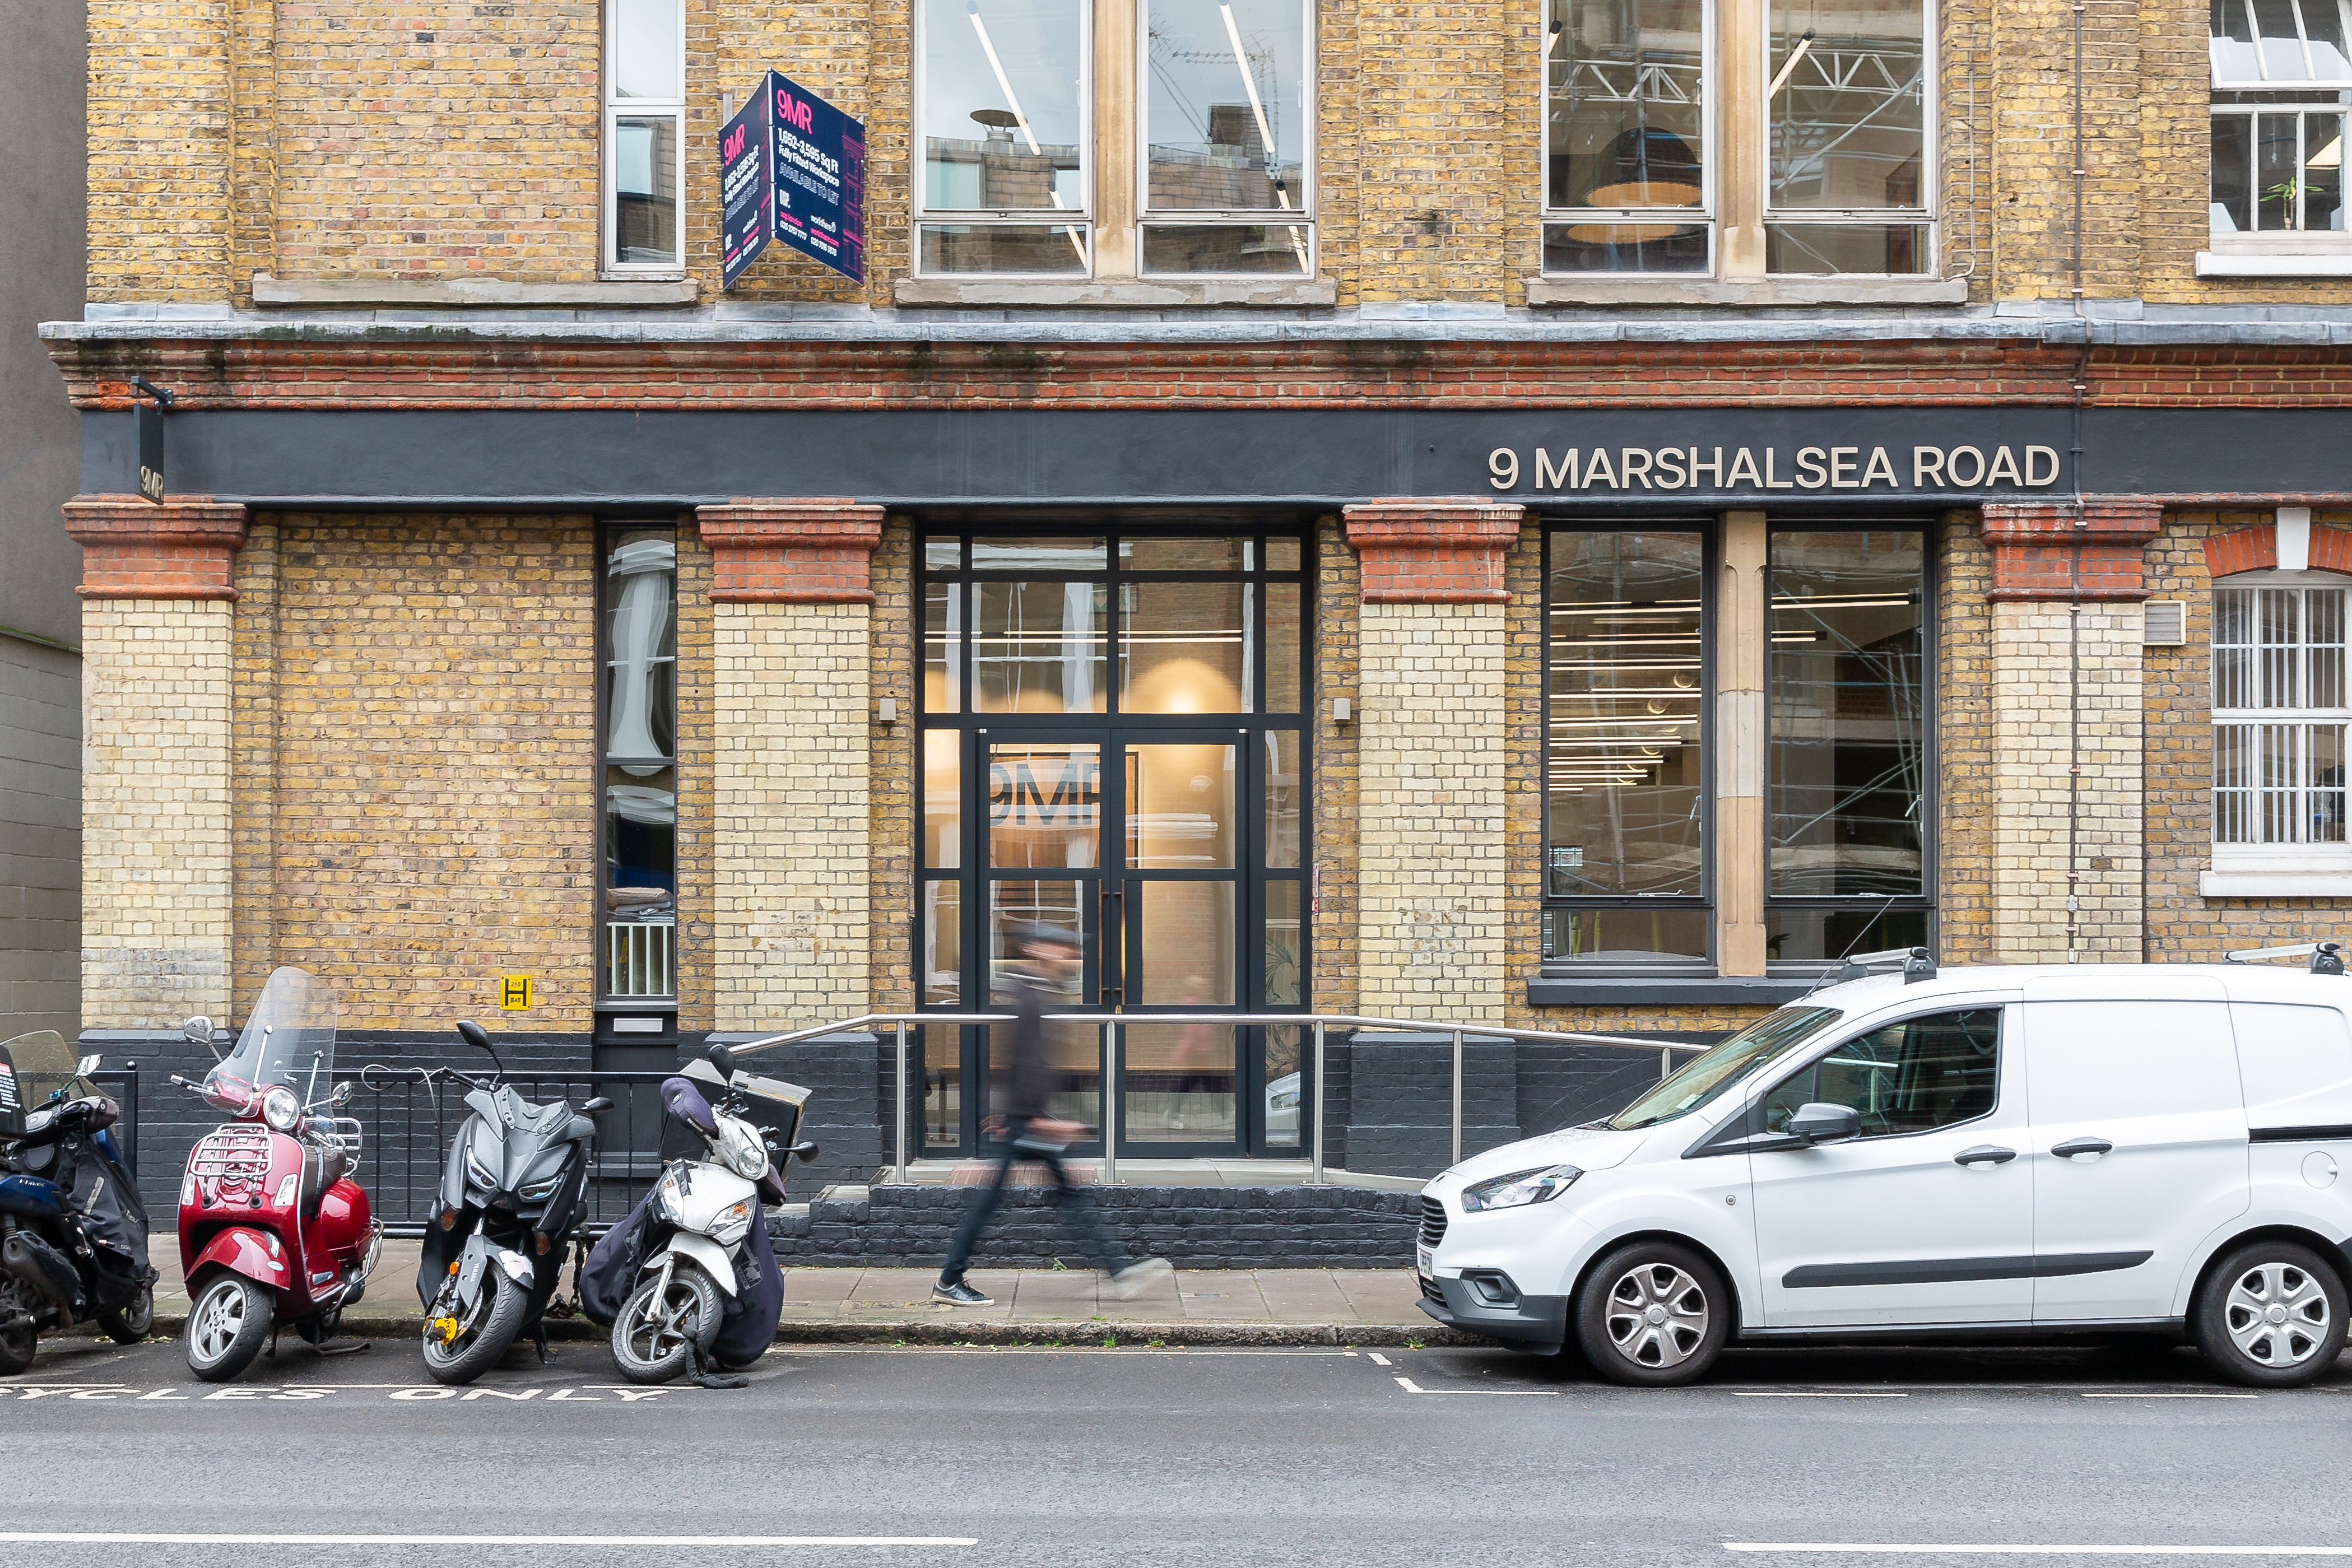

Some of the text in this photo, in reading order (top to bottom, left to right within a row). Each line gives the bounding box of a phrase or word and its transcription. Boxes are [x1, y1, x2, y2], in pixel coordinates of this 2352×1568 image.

[777, 89, 812, 134] 9MR
[724, 123, 745, 166] 9MR
[778, 145, 792, 162] Fully
[820, 153, 831, 173] Sq
[831, 159, 839, 174] Ft
[817, 183, 828, 198] TO
[828, 189, 839, 206] LET
[1488, 445, 2060, 489] 9 MARSHALSEA ROAD
[141, 465, 163, 501] 9MR
[470, 1262, 480, 1282] YAMAHA
[388, 1387, 670, 1402] ONLY
